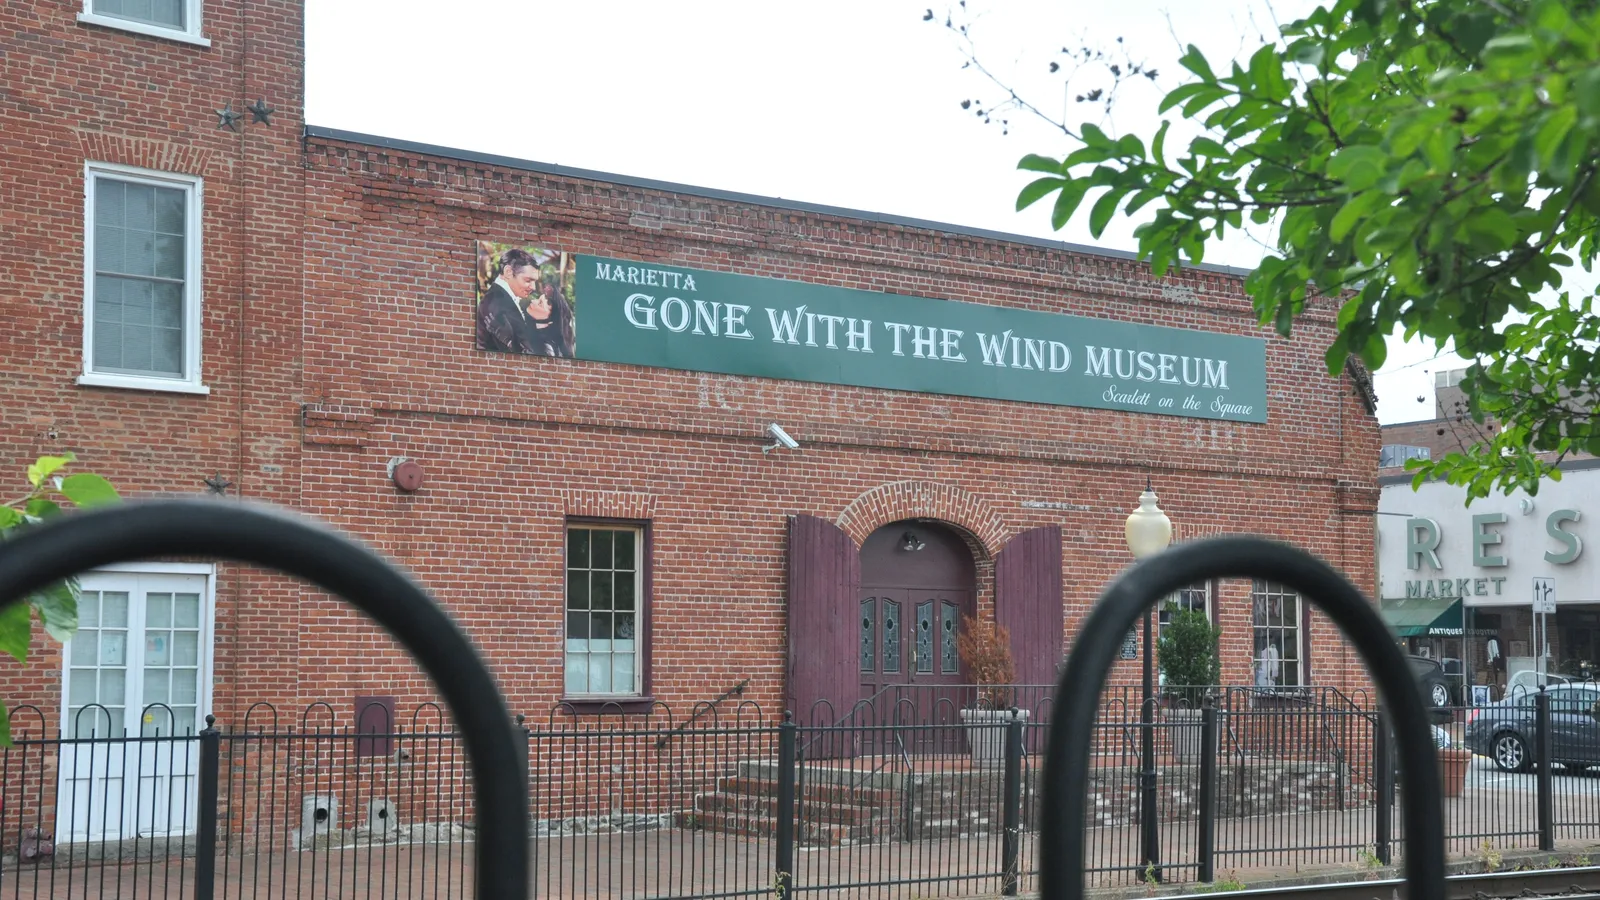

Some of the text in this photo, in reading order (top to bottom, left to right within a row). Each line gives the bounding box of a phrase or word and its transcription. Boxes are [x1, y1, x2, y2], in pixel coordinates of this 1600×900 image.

[595, 262, 697, 291] MARIETTA
[623, 293, 1229, 390] GONE WITH THE WIND MUSEUM
[1102, 384, 1253, 417] Scarlett on the Square
[1378, 498, 1583, 570] RE'S
[1405, 577, 1506, 599] MARKET
[1428, 627, 1464, 636] ANTIQUES
